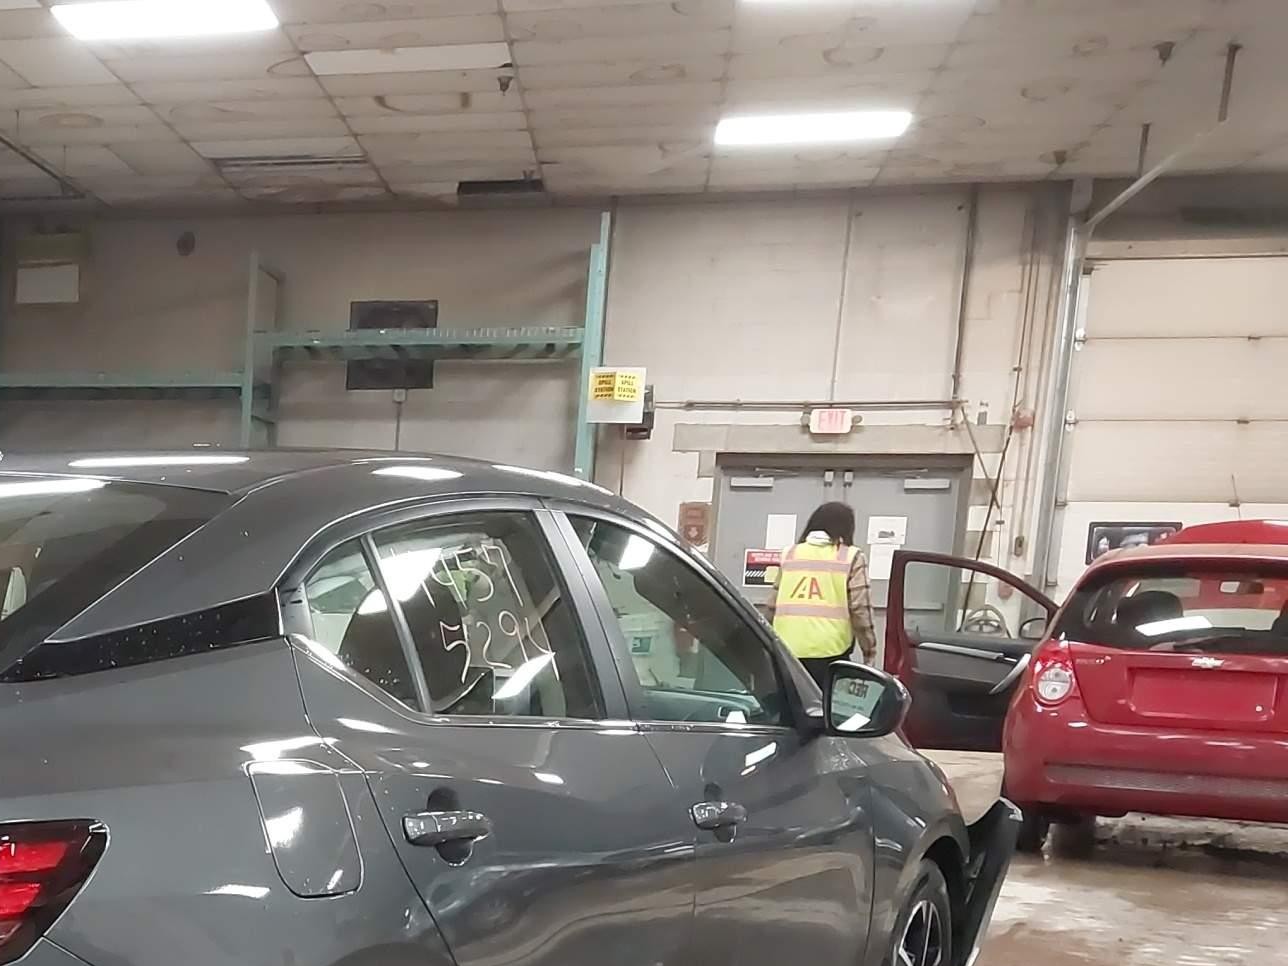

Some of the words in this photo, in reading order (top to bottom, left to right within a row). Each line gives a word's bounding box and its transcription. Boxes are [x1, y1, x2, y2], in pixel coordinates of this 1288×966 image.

[818, 410, 847, 431] EXIT
[390, 543, 524, 609] 457
[439, 610, 560, 684] 5294
